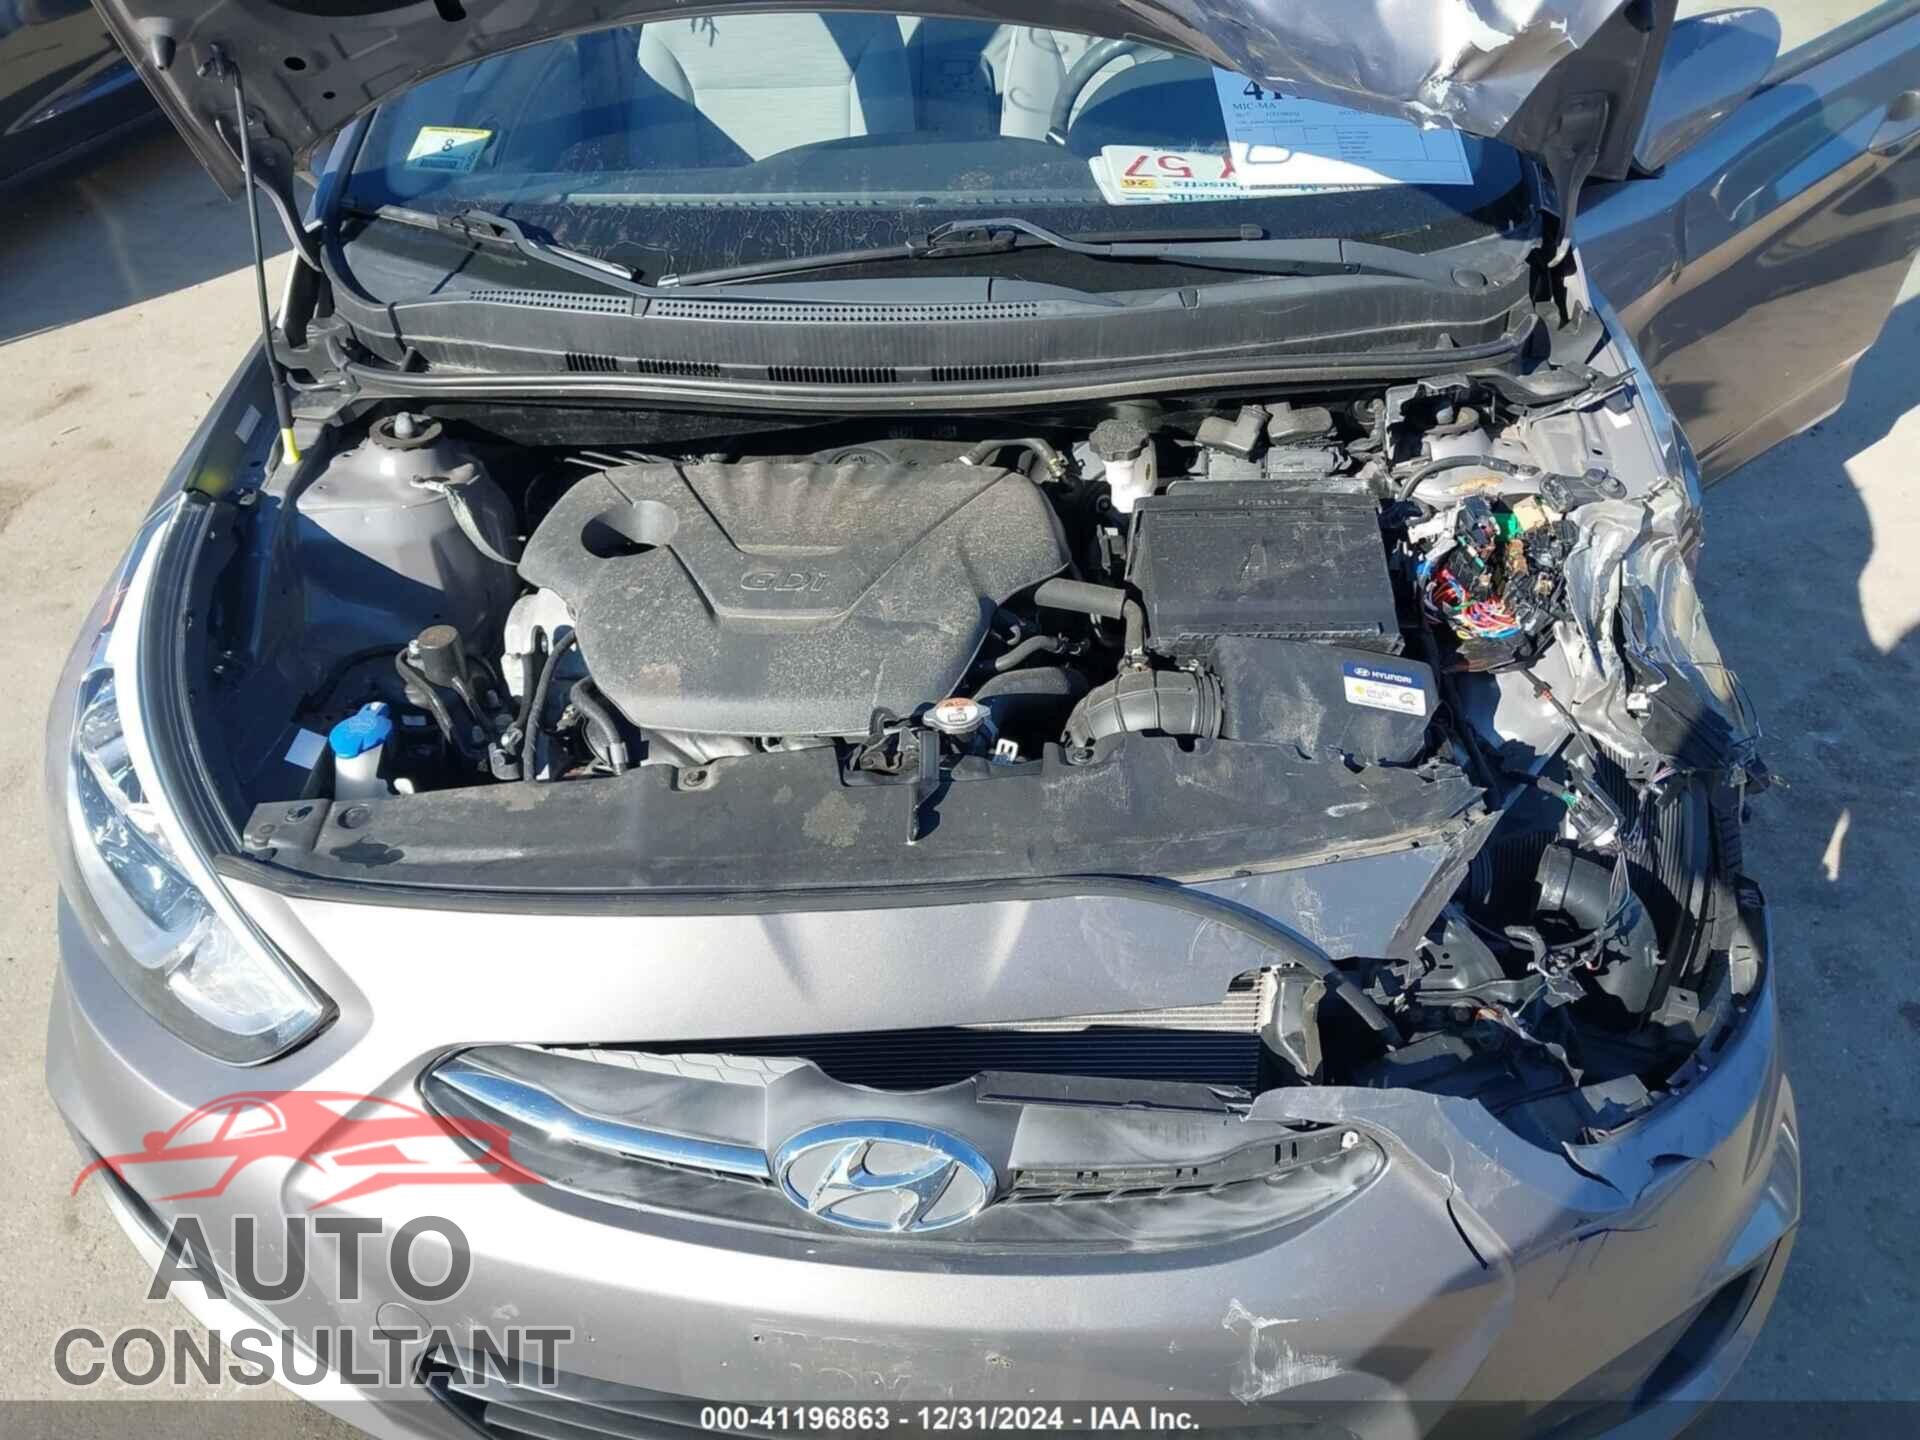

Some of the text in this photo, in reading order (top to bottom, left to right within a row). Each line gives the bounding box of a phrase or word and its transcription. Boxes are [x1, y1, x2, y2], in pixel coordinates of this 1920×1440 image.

[442, 138, 455, 152] 8
[1124, 155, 1193, 178] 57
[1372, 670, 1412, 684] HYUNDAI
